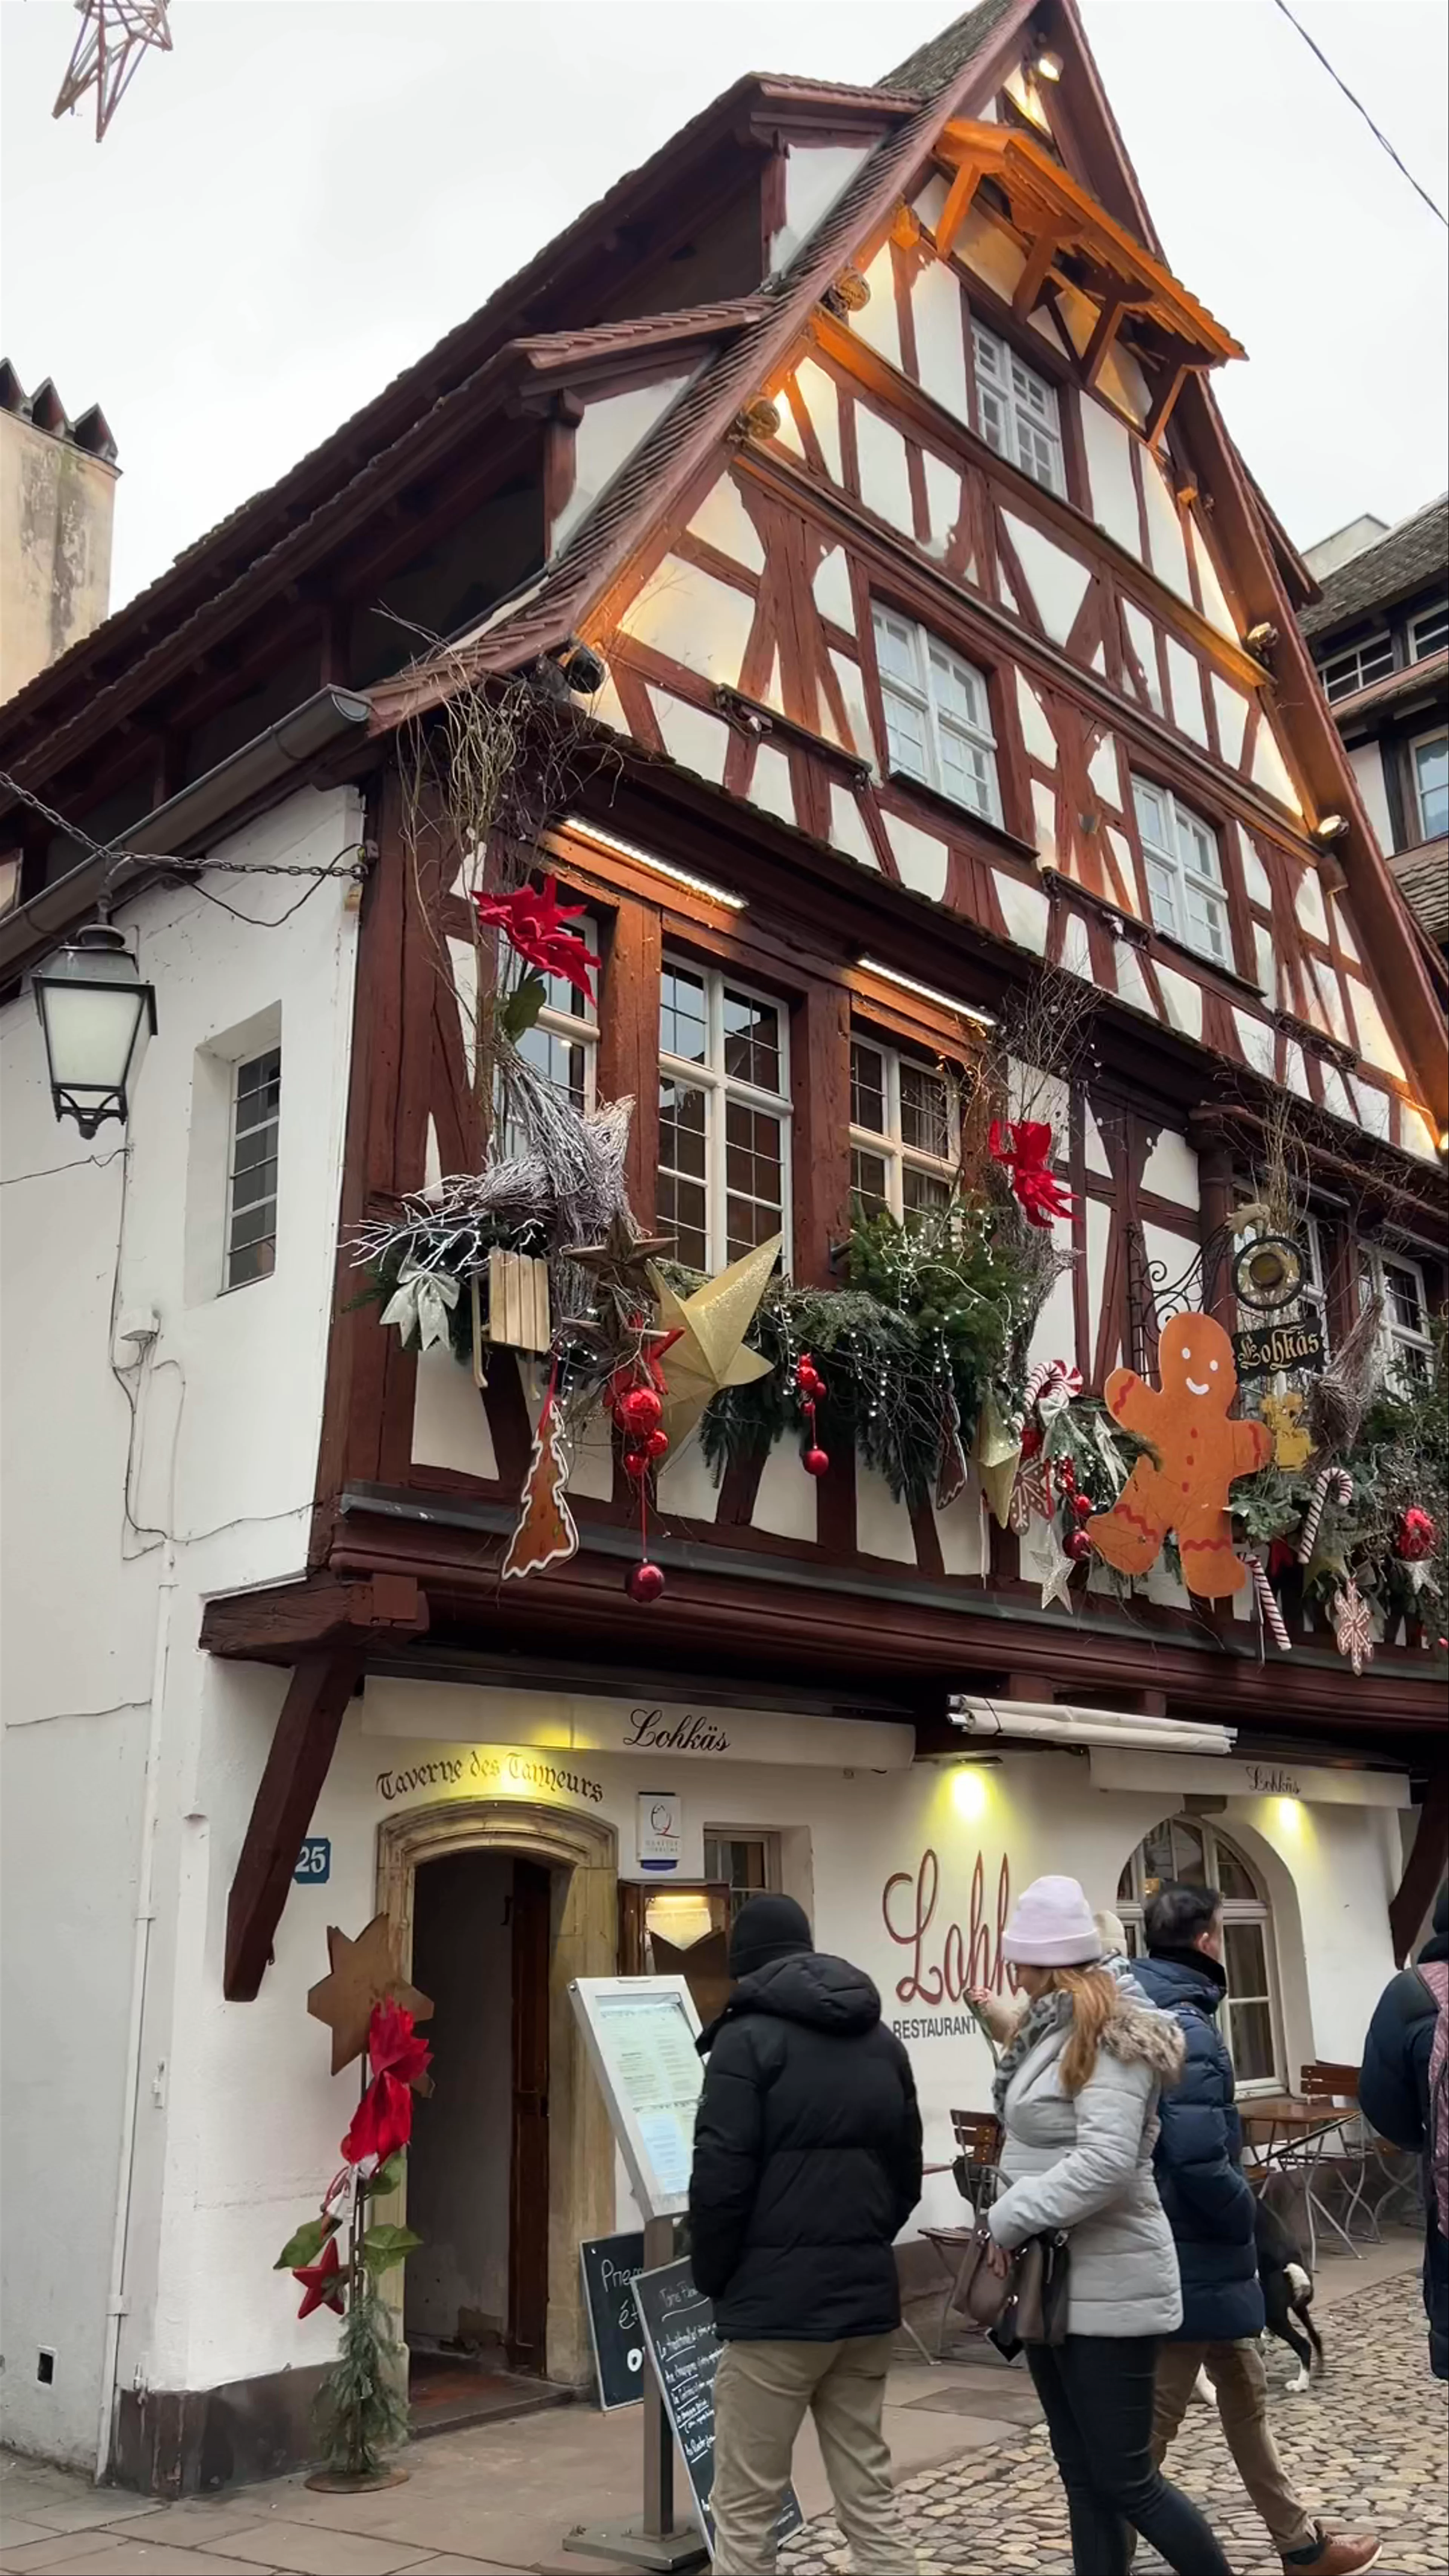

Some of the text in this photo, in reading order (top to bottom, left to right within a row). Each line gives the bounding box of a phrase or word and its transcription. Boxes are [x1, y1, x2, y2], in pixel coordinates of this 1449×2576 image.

[1238, 1324, 1319, 1370] Lohkäs
[623, 1708, 730, 1751] Lohkäs
[377, 1750, 603, 1802] Taverne des Tanneurs
[295, 1846, 326, 1873] 25
[893, 2015, 976, 2039] RESTAURANT
